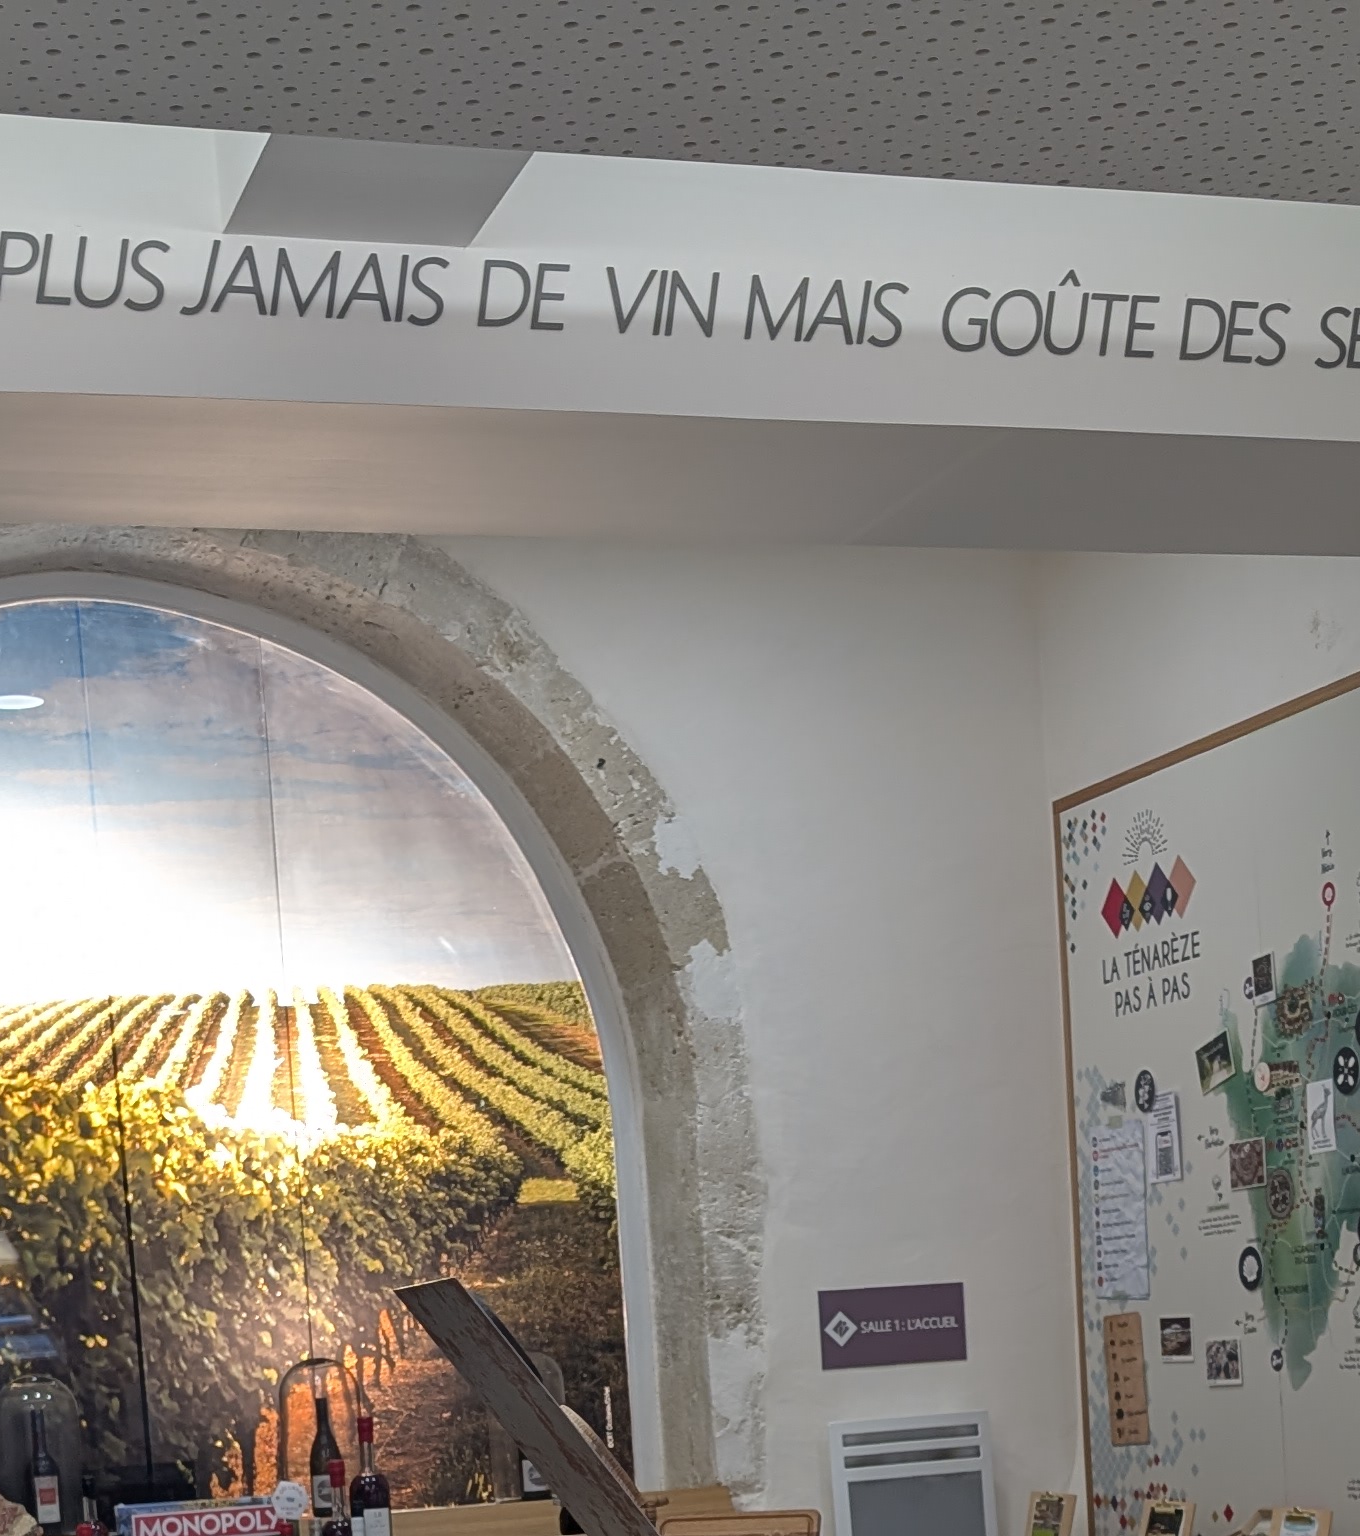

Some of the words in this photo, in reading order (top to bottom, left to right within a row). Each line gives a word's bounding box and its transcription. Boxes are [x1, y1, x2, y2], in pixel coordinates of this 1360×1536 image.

[182, 239, 451, 328] JAMAIS
[476, 258, 571, 332] DE
[606, 265, 720, 339] VIN
[743, 273, 910, 348] MAIS
[941, 271, 1163, 361] GOÛTE
[1178, 298, 1289, 369] DES
[1101, 957, 1121, 985] LA
[1123, 930, 1201, 980] TÉNARÈZE
[1114, 988, 1142, 1018] PAS
[1146, 981, 1159, 1010] À
[1161, 971, 1191, 1002] PAS
[861, 1320, 892, 1334] SALLE
[907, 1316, 959, 1331] L'ACCUEIL
